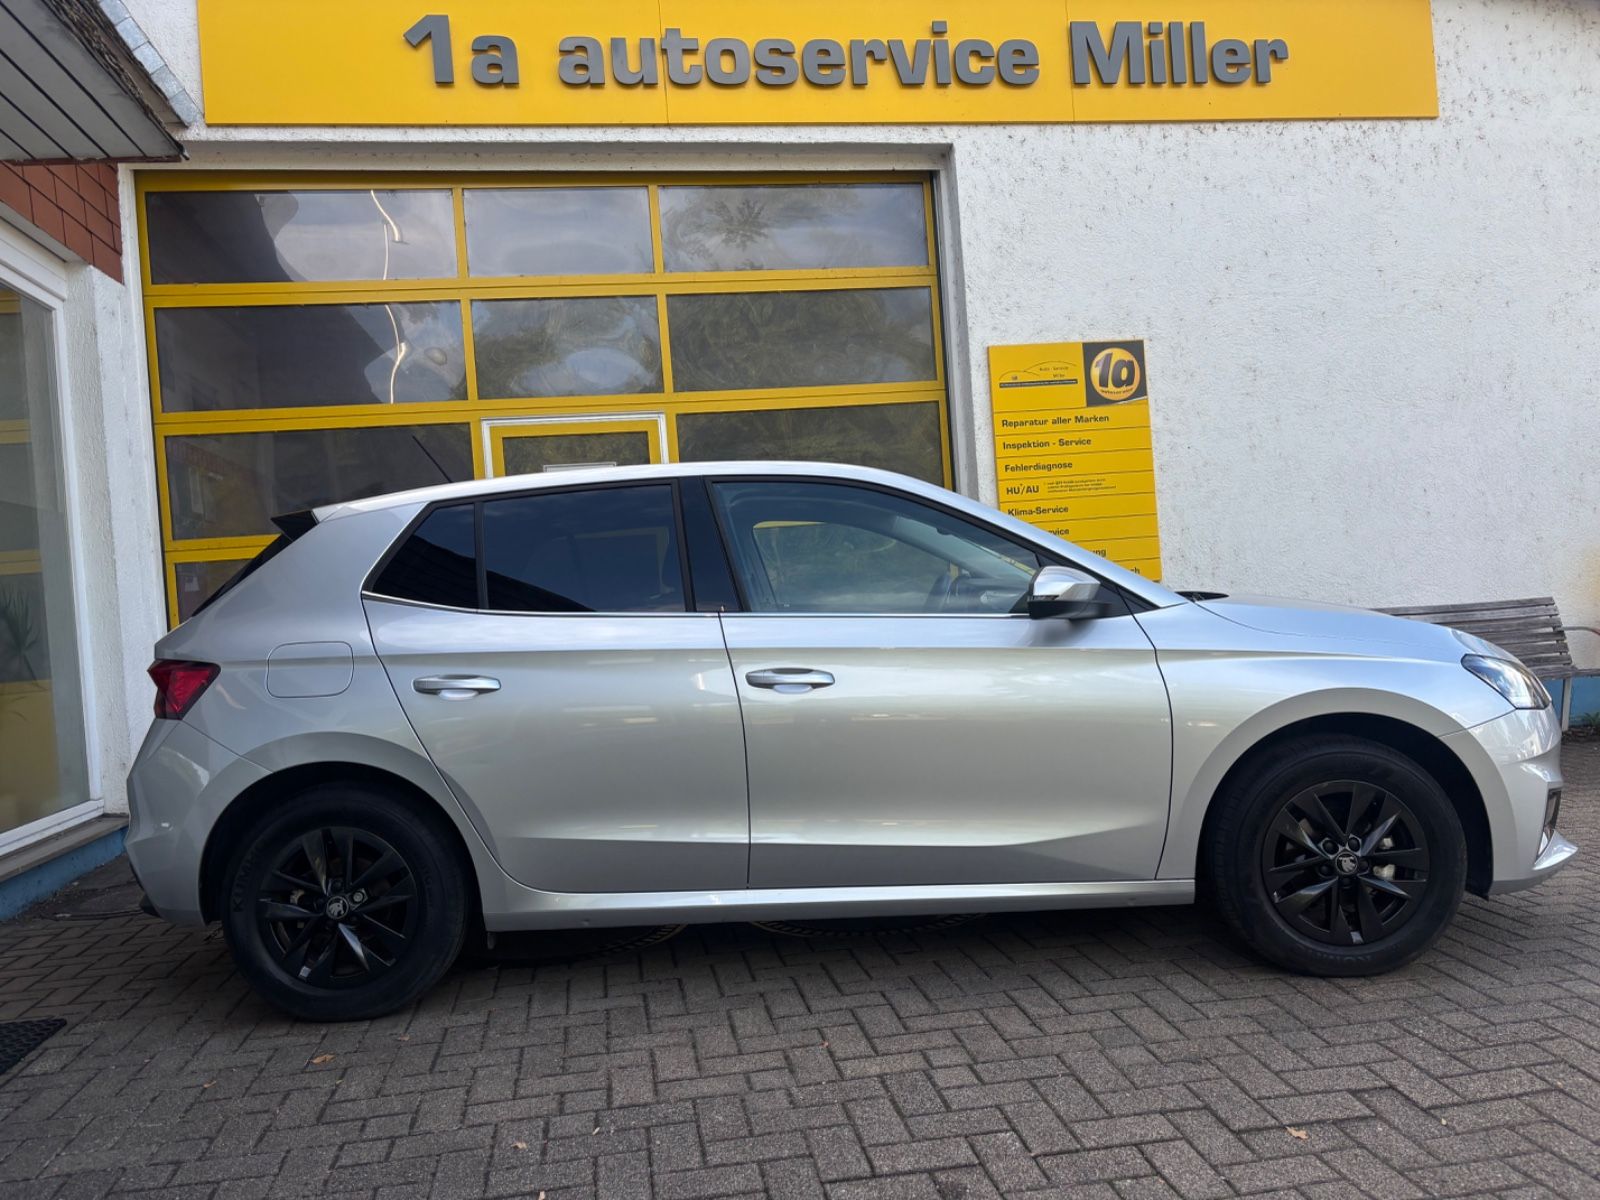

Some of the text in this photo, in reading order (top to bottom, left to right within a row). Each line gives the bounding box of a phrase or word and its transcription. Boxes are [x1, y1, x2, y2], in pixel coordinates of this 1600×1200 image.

[402, 14, 1289, 87] 1a autoservice Miller
[1095, 352, 1135, 388] 1a
[1001, 415, 1109, 429] Reparatur aller Marken
[1003, 441, 1050, 451] Inspektion
[1058, 438, 1092, 447] Service
[1004, 461, 1073, 473] Fehlerdiagnose
[1007, 505, 1069, 517] Klima-Service
